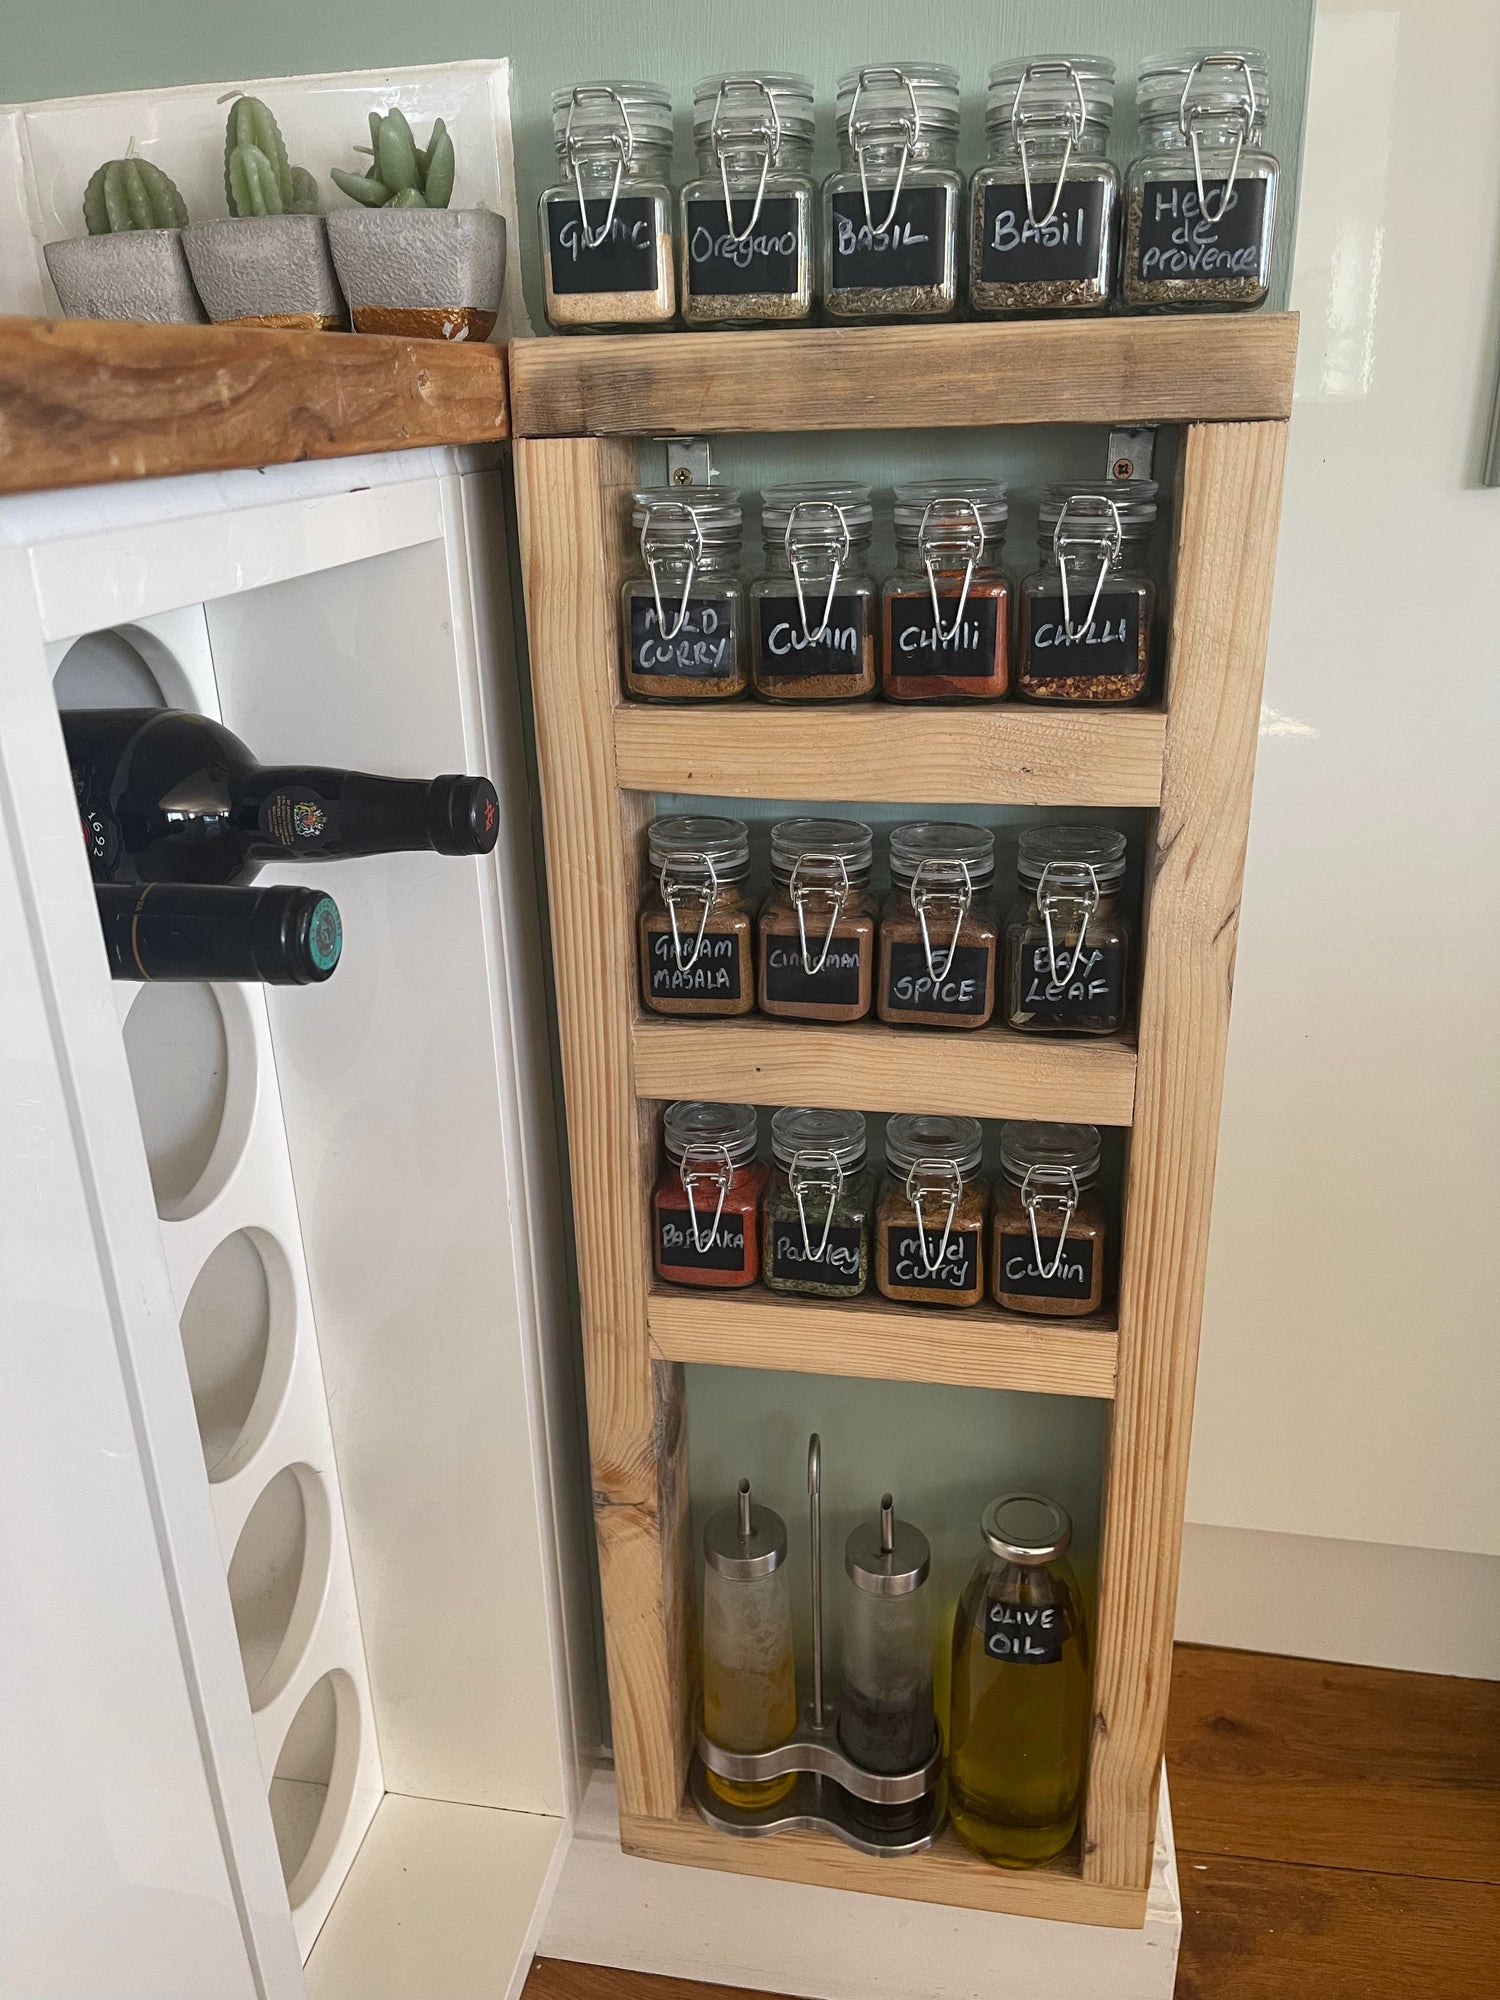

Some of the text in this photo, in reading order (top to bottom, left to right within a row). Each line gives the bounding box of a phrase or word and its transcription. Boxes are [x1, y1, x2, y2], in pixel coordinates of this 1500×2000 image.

[838, 220, 929, 255] BASIL
[1171, 218, 1218, 245] de
[690, 226, 796, 268] Oregano
[645, 607, 718, 635] MILD
[1034, 617, 1127, 648] CHILLI
[639, 637, 726, 668] CURRY
[87, 811, 106, 857] 1692
[654, 934, 732, 961] GARAM
[927, 949, 951, 975] 5
[1033, 946, 1105, 978] BAY
[653, 967, 731, 990] MASALA
[893, 975, 977, 1004] SPICE
[1024, 977, 1110, 1004] LEAF
[661, 1222, 745, 1249] PAPRIKA
[989, 1602, 1055, 1629] OLIVE
[988, 1632, 1047, 1655] OIL
